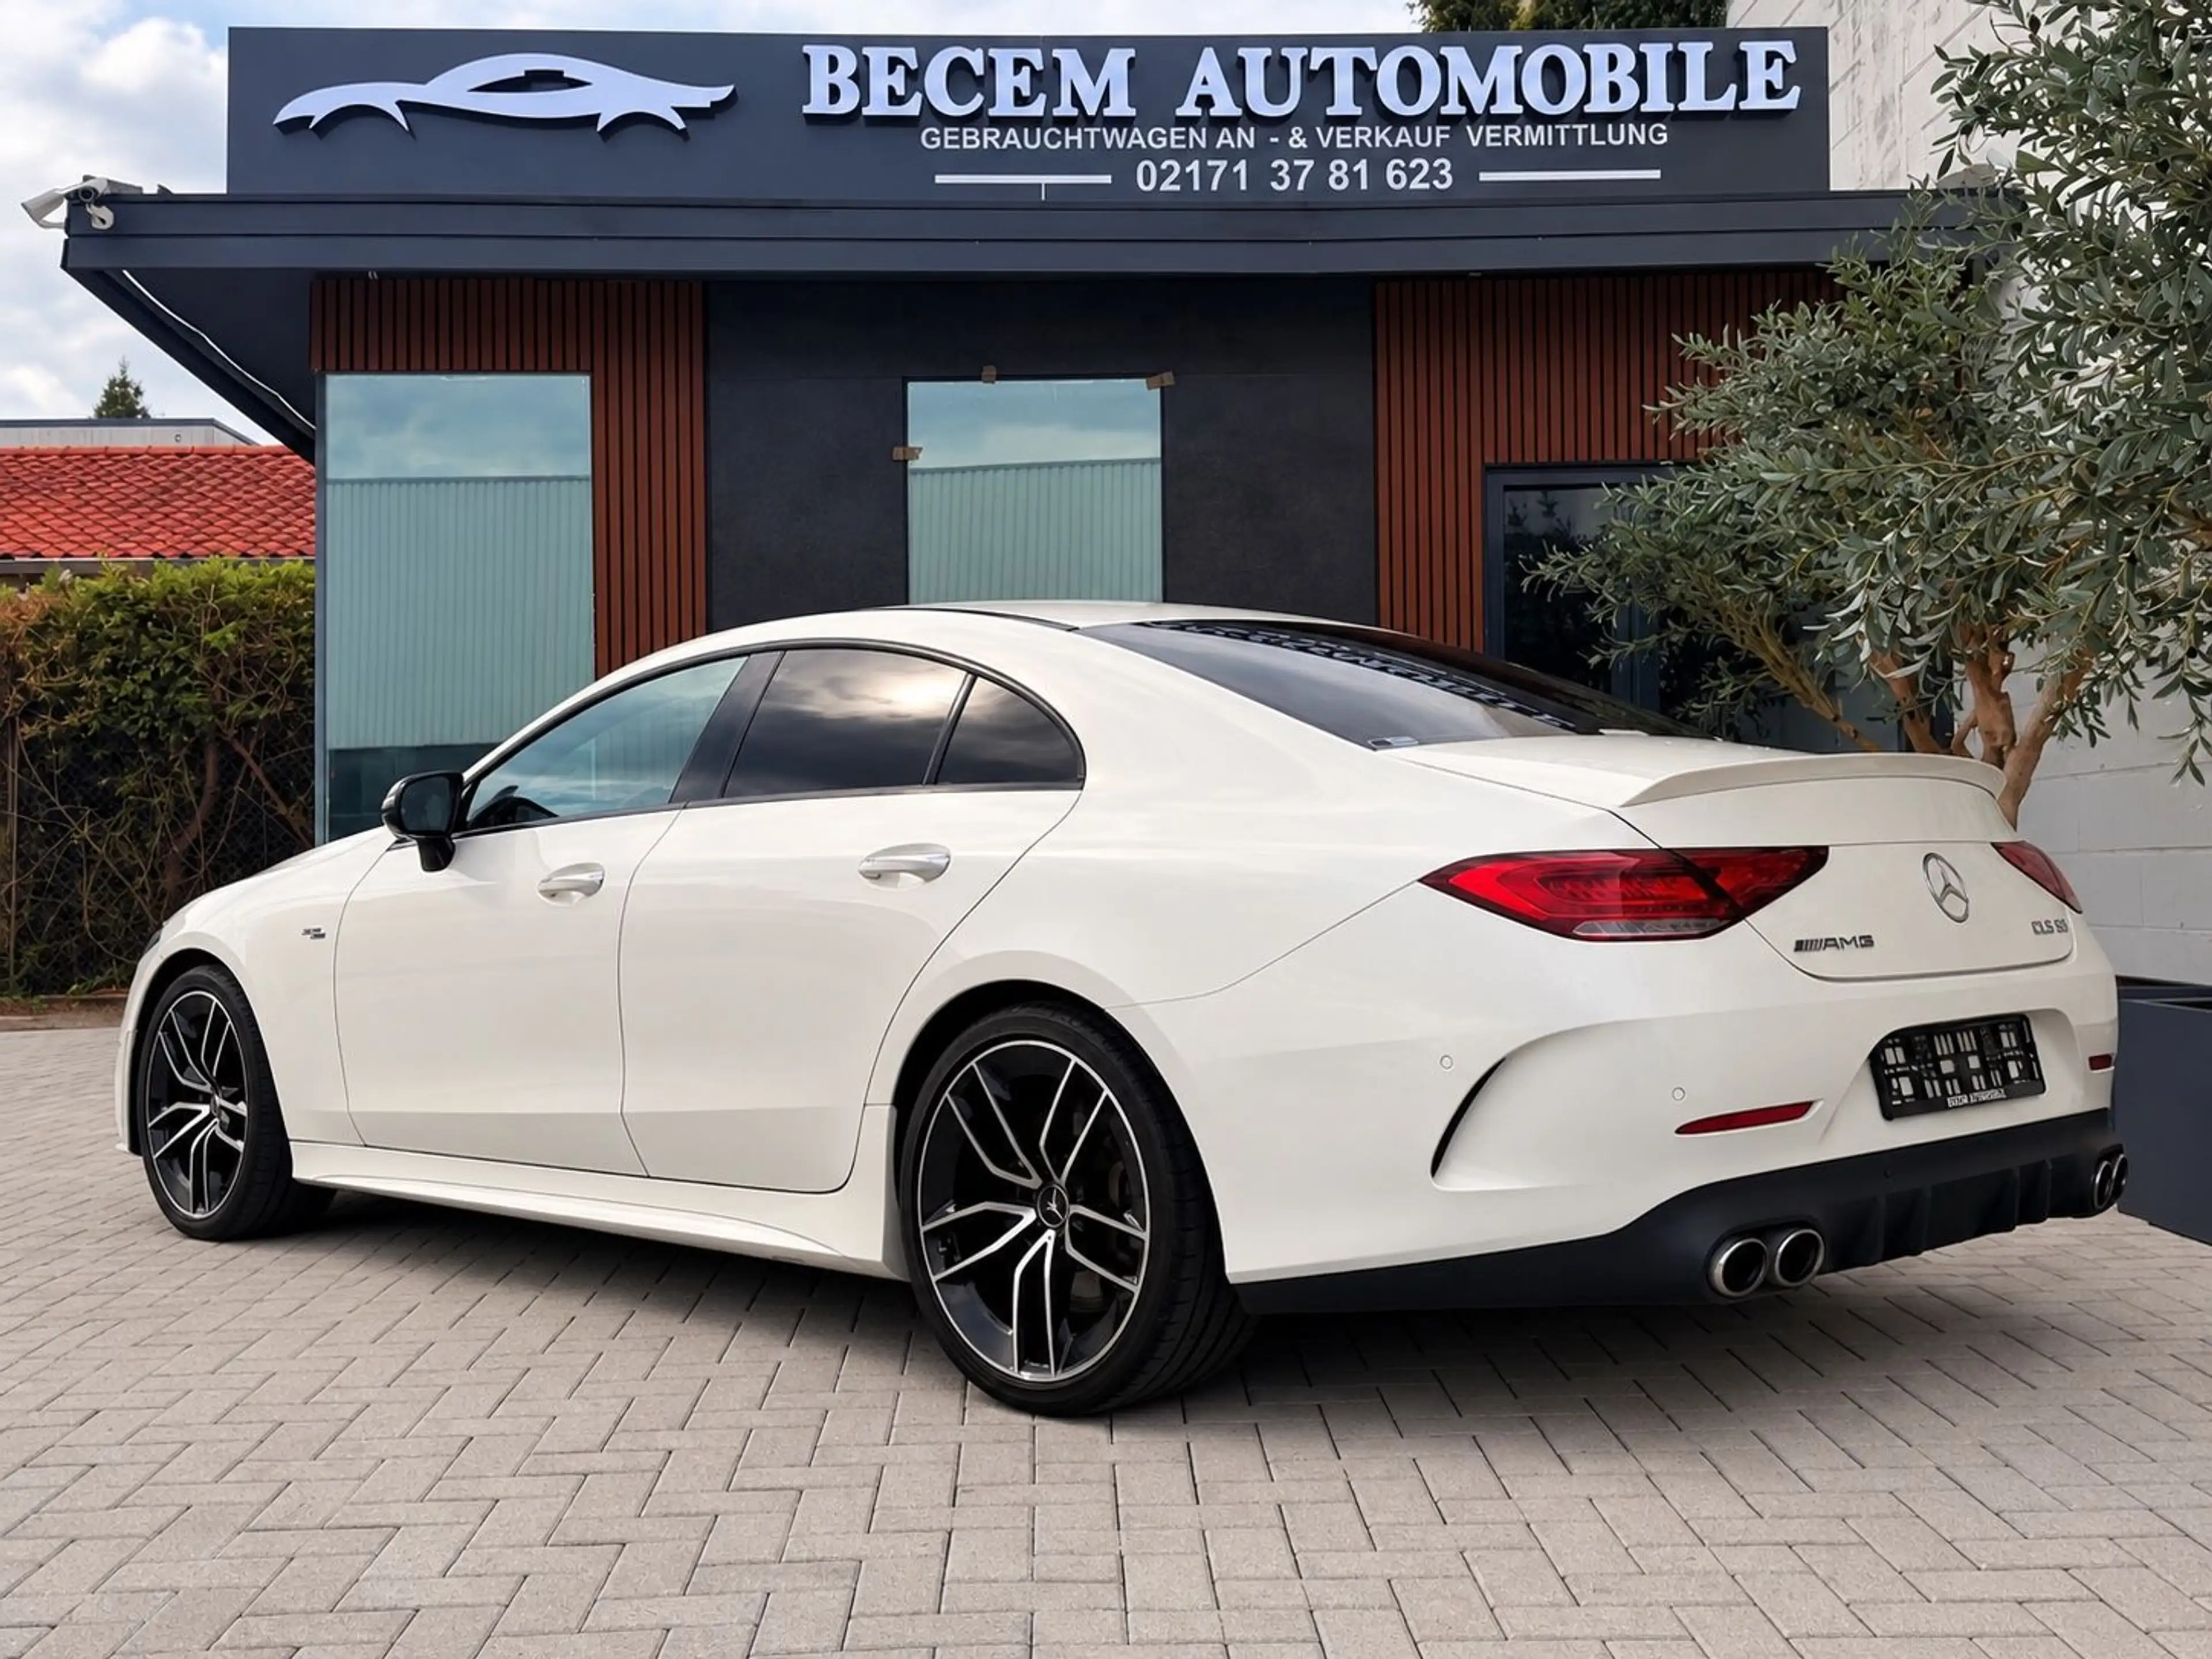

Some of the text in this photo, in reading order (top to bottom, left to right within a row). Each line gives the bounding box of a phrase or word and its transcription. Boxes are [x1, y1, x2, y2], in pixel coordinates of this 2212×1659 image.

[802, 40, 1801, 117] BECEM AUTOMOBILE
[921, 127, 1207, 150] GEBRAUCHTWAGEN
[1215, 126, 1255, 149] AN
[1287, 126, 1309, 149] &
[1315, 126, 1451, 149] VERKAUF
[1466, 123, 1668, 147] VERMITTLUNG
[1136, 157, 1453, 192] 02171 37 81 623
[1823, 934, 1874, 951] AMG
